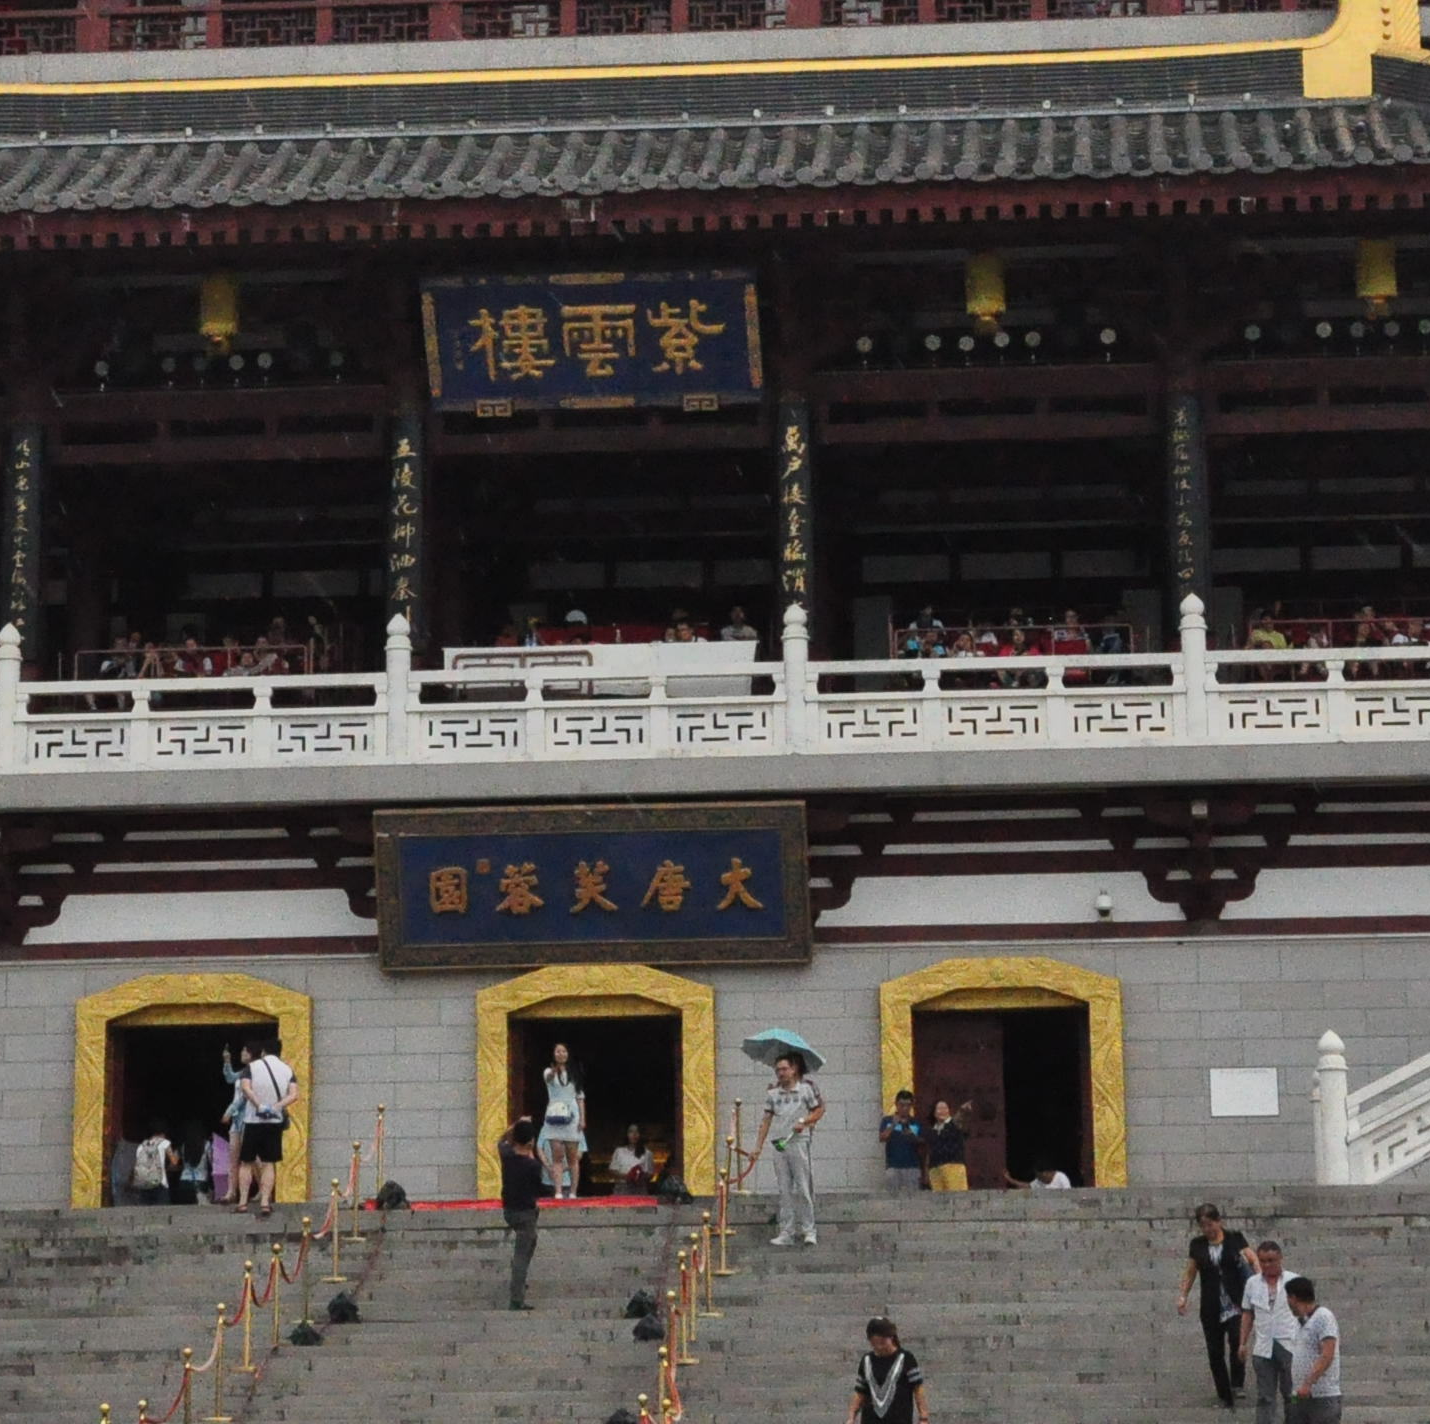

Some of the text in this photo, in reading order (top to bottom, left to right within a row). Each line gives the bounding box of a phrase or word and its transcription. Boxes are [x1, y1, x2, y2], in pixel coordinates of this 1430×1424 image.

[469, 298, 725, 382] 紫雲樓
[429, 856, 764, 915] 大唐芙蓉園
